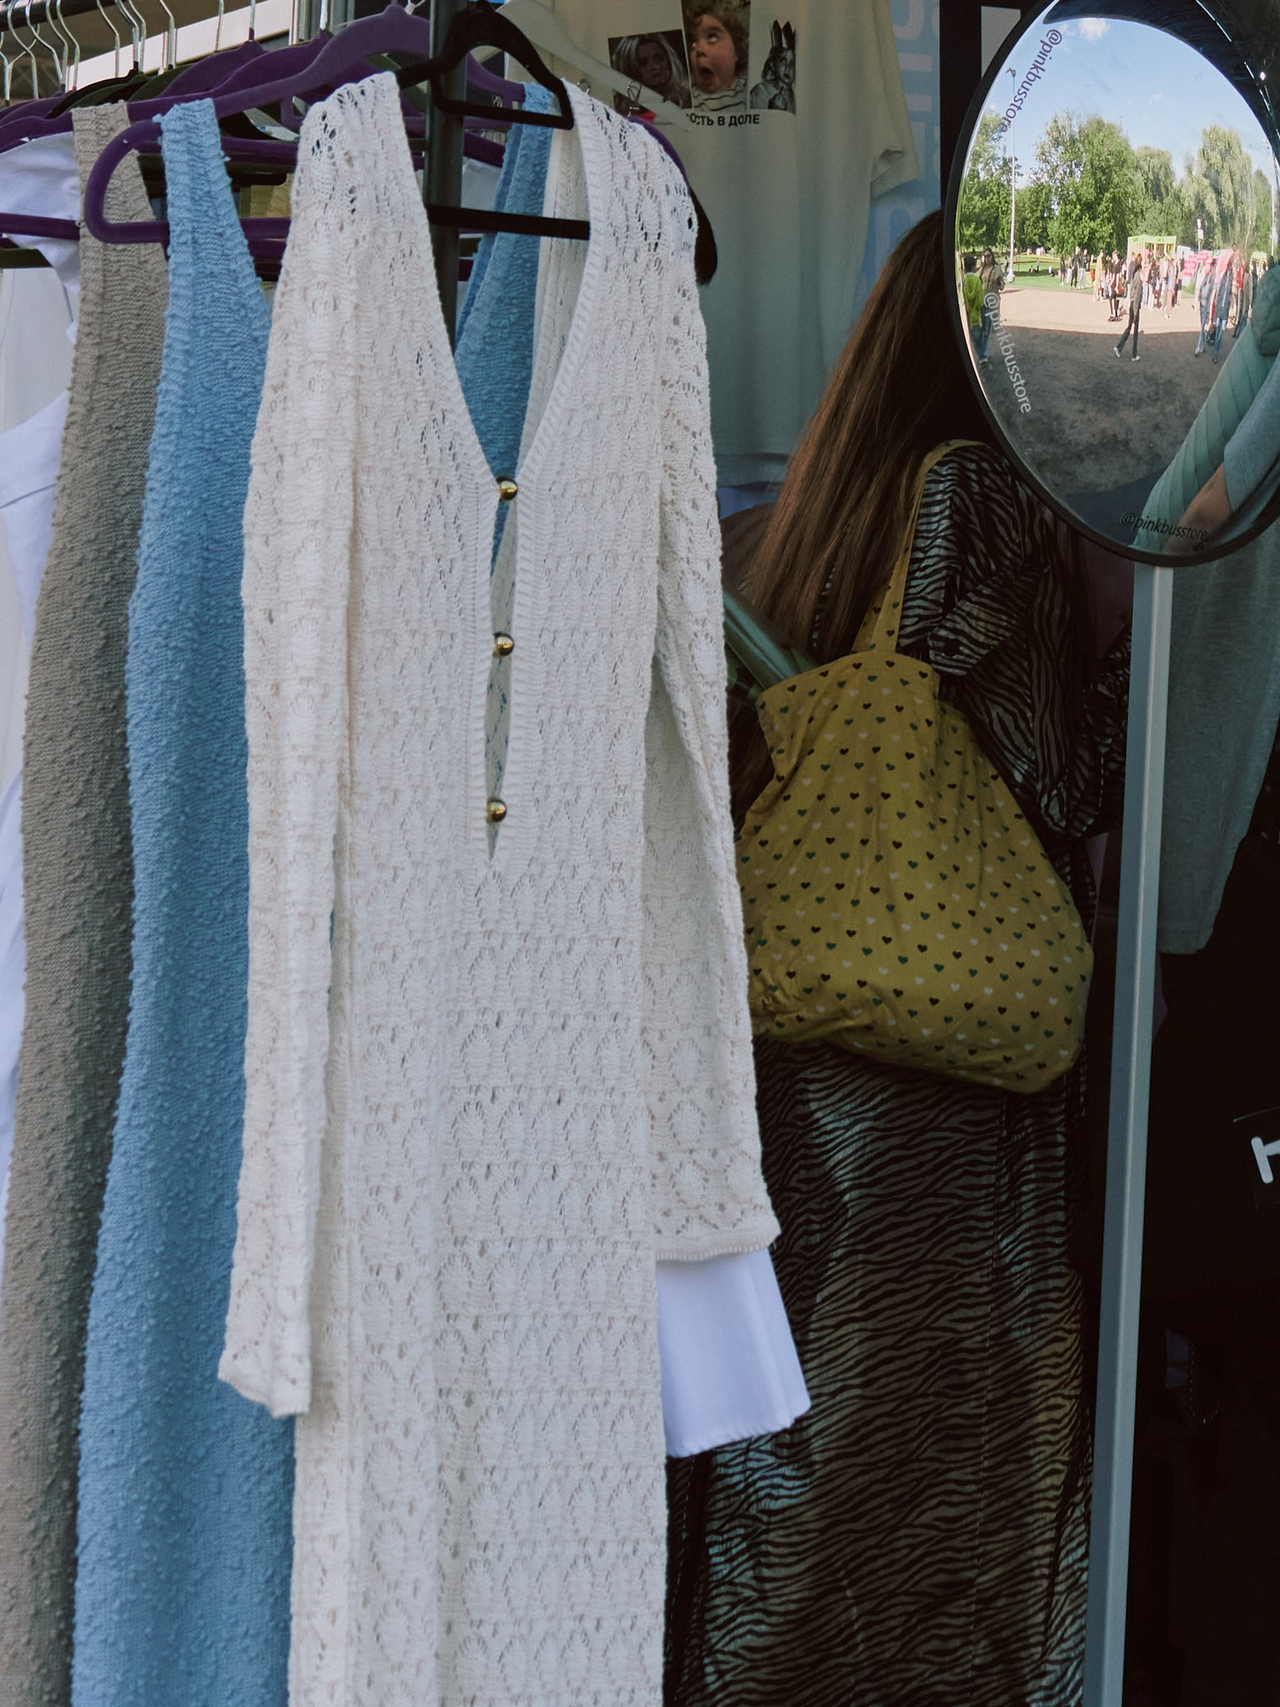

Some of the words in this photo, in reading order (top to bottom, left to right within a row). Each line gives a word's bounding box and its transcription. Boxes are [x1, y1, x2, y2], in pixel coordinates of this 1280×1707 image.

[1000, 29, 1063, 133] @pinkbusstore
[686, 112, 714, 126] ОСТЬ
[717, 115, 726, 126] В
[728, 114, 761, 128] ДОЛЕ
[983, 292, 1032, 413] @pinkbusstore
[1121, 512, 1208, 540] @pinkbusstore
